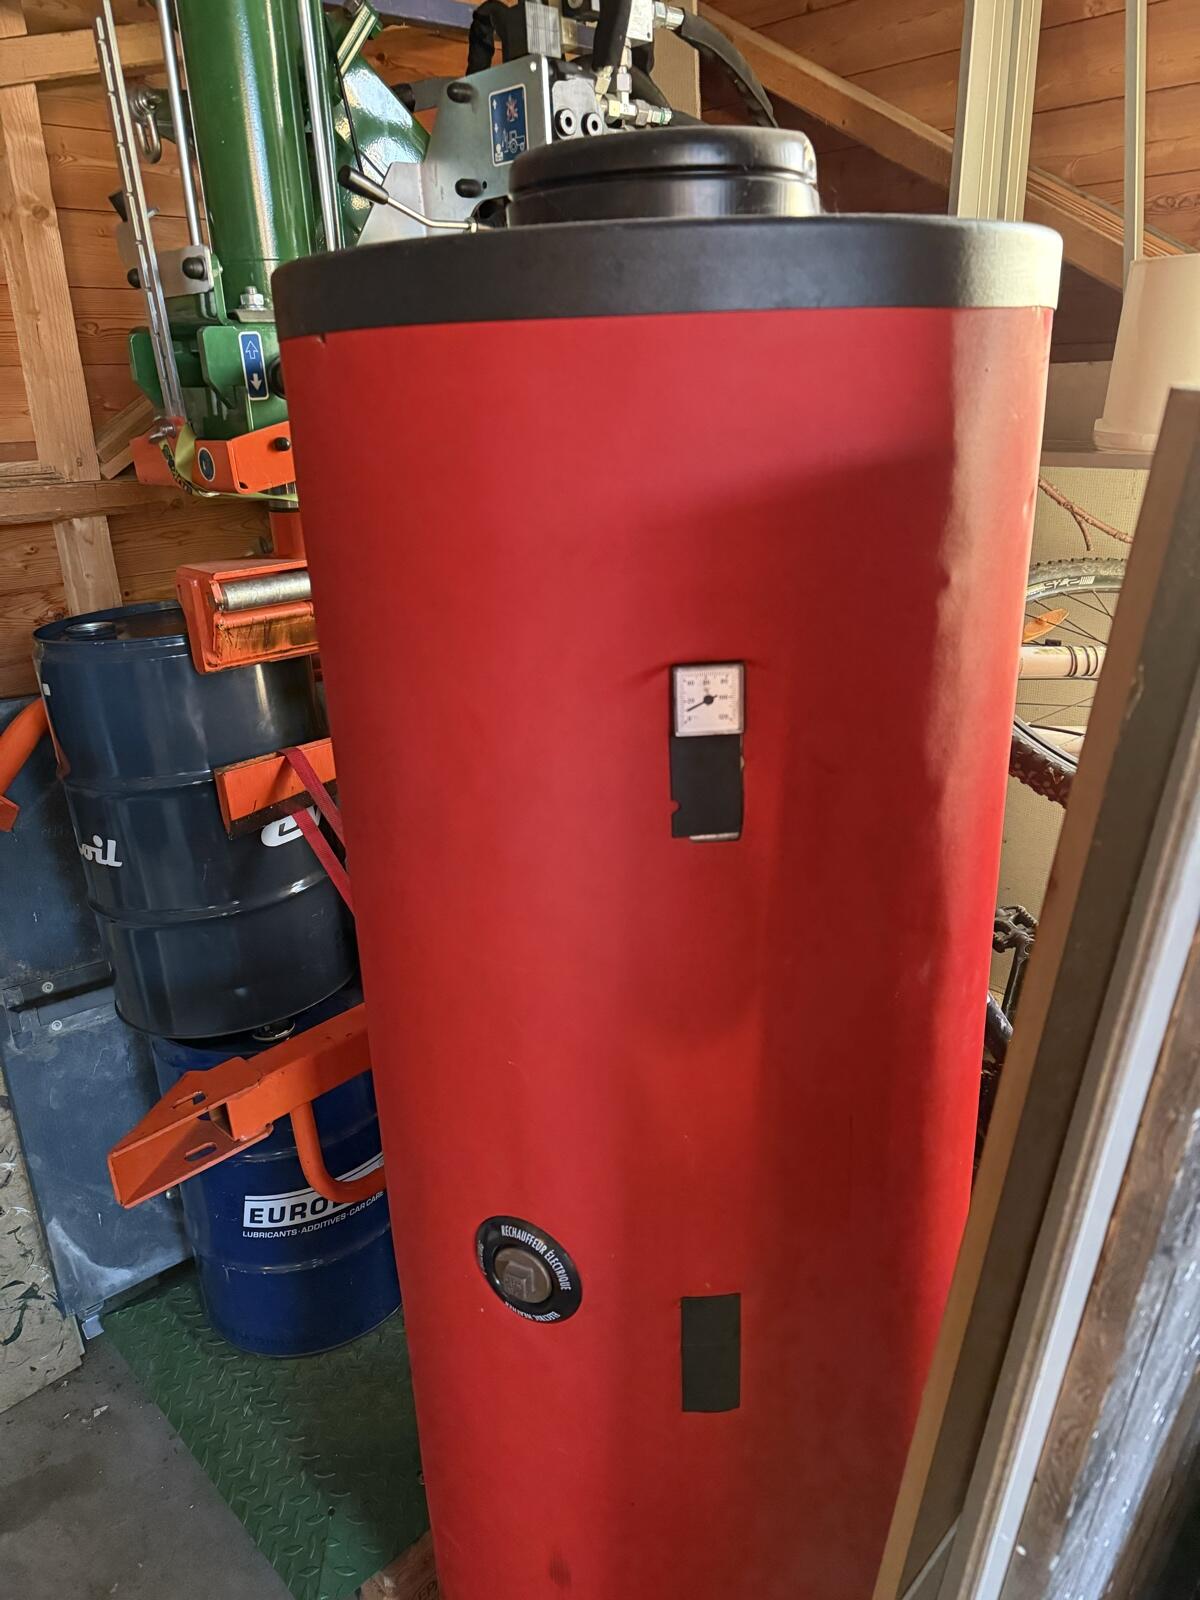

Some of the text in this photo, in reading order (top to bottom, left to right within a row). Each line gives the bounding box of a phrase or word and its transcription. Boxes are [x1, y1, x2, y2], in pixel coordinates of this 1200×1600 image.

[80, 834, 123, 867] oil
[242, 1228, 298, 1239] LUBRICANTS
[300, 1212, 347, 1234] ADDITIVES
[349, 1202, 366, 1217] CAR
[249, 1196, 343, 1224] EURO
[543, 1249, 572, 1291] ÉLECTRIQUE
